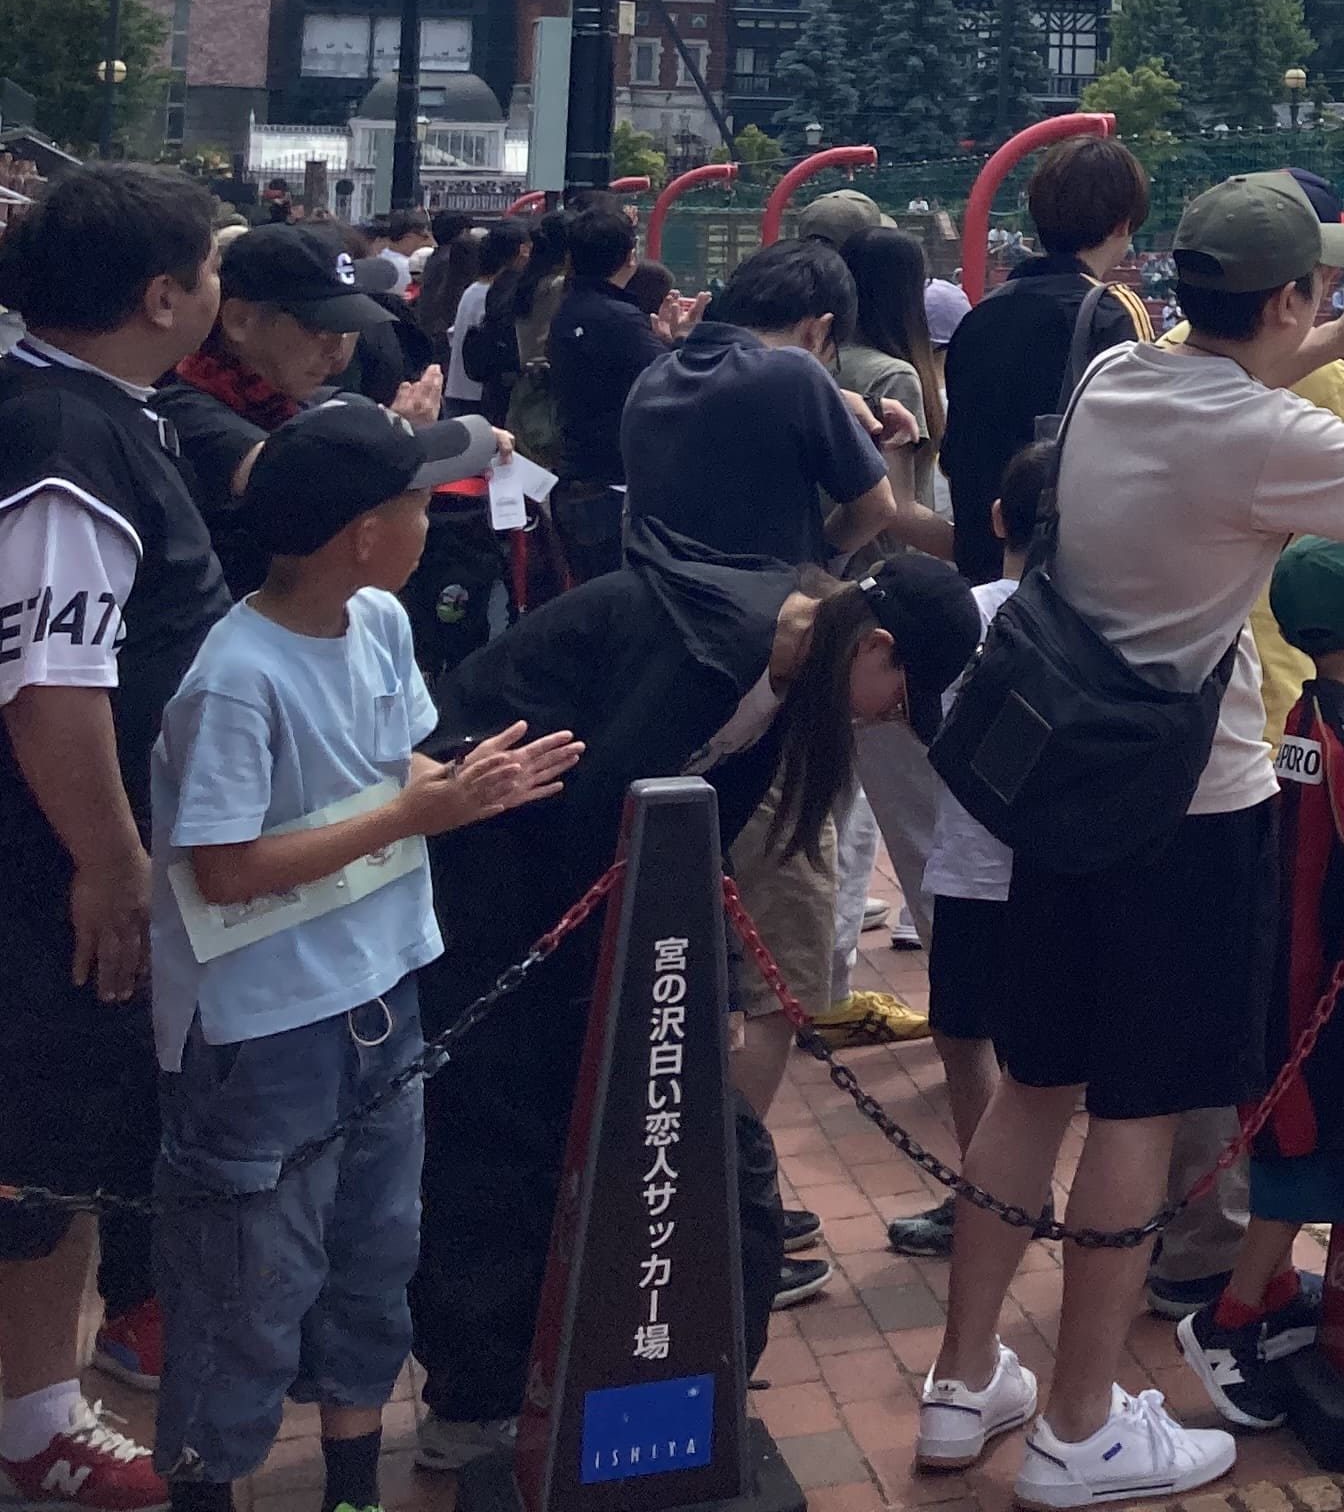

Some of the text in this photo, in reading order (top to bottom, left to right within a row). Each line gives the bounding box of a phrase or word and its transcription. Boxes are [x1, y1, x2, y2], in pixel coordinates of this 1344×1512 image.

[633, 935, 689, 1361] 宮の沢白い恋人サッカー場
[594, 1438, 696, 1470] ISHIYA
